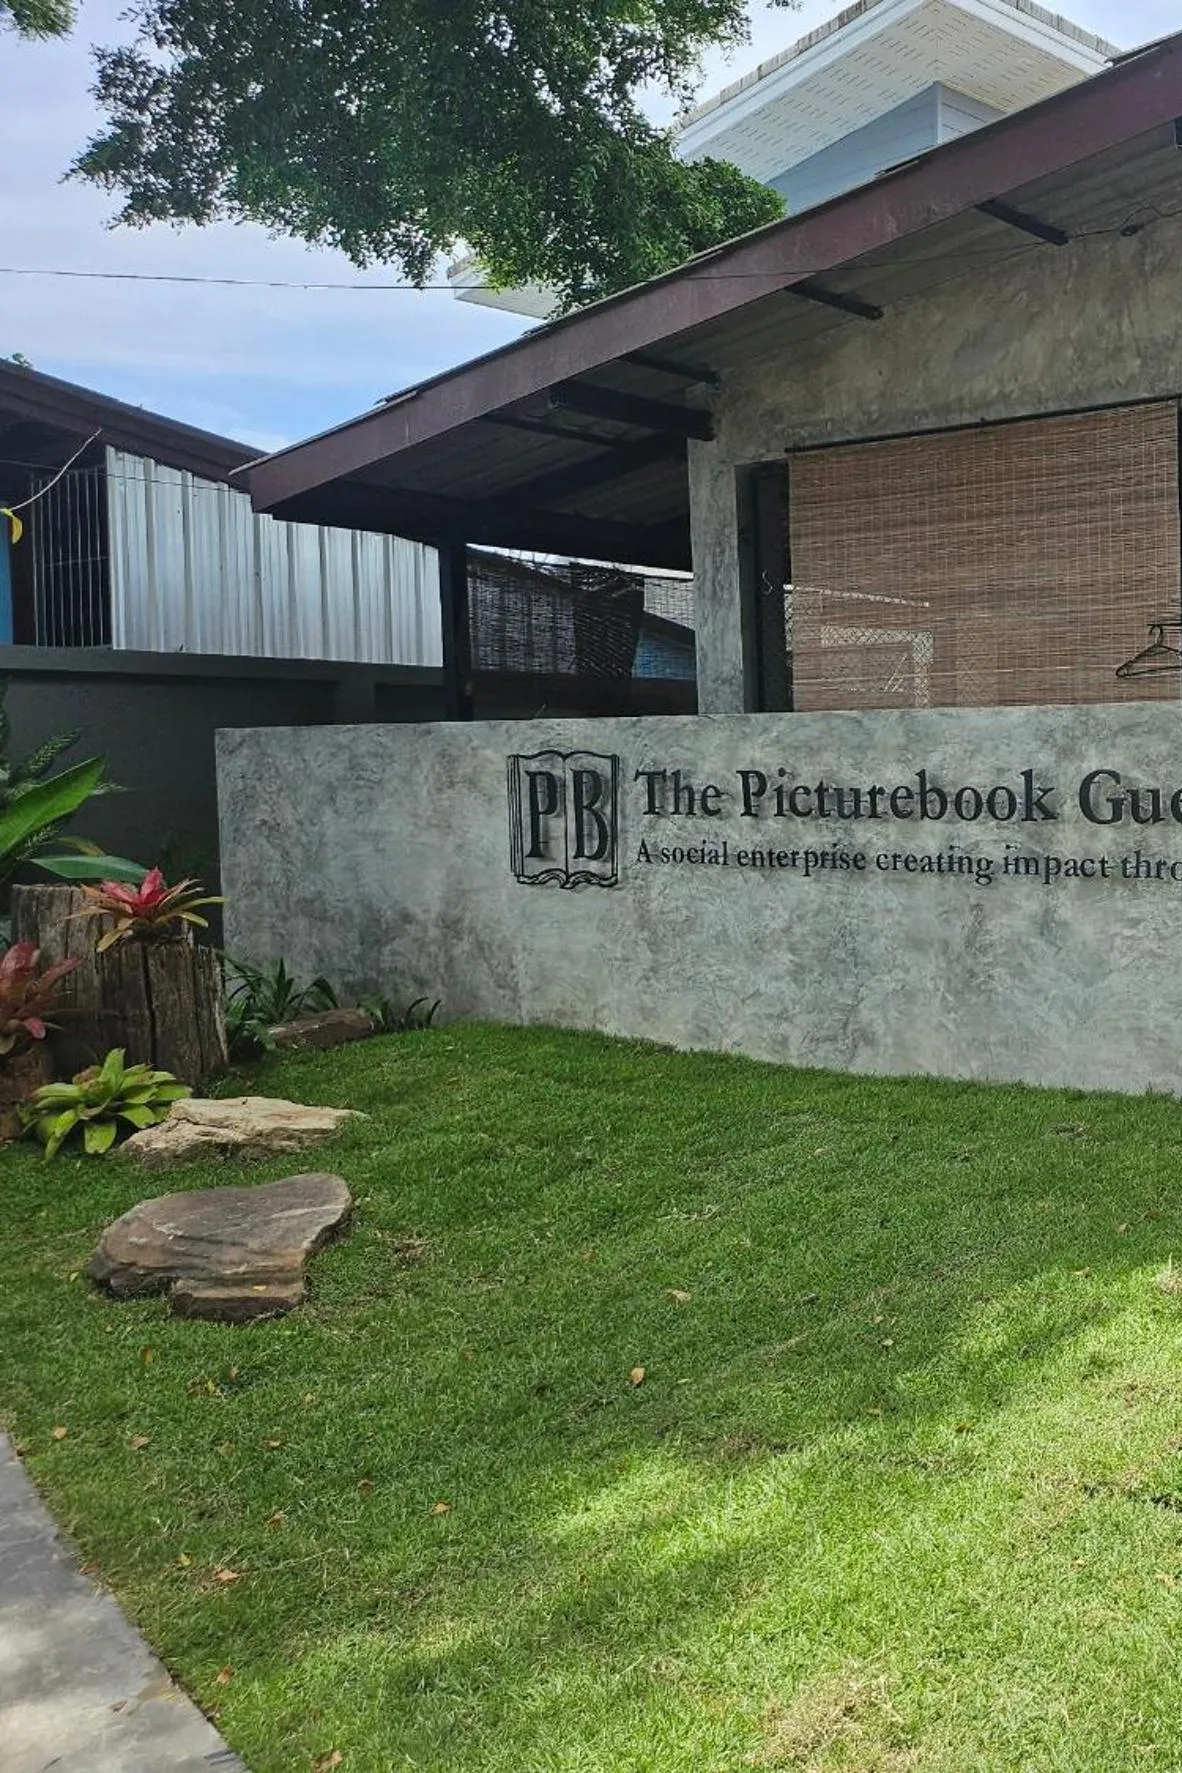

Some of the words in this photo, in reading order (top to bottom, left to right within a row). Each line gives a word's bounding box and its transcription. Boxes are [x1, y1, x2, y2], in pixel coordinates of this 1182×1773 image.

[525, 770, 609, 860] PB
[635, 768, 723, 817] The
[736, 767, 1058, 823] Picturebook
[637, 839, 656, 863] A
[660, 840, 728, 867] social
[736, 844, 866, 876] enterprise
[875, 845, 993, 886] creating
[1002, 844, 1111, 885] impact
